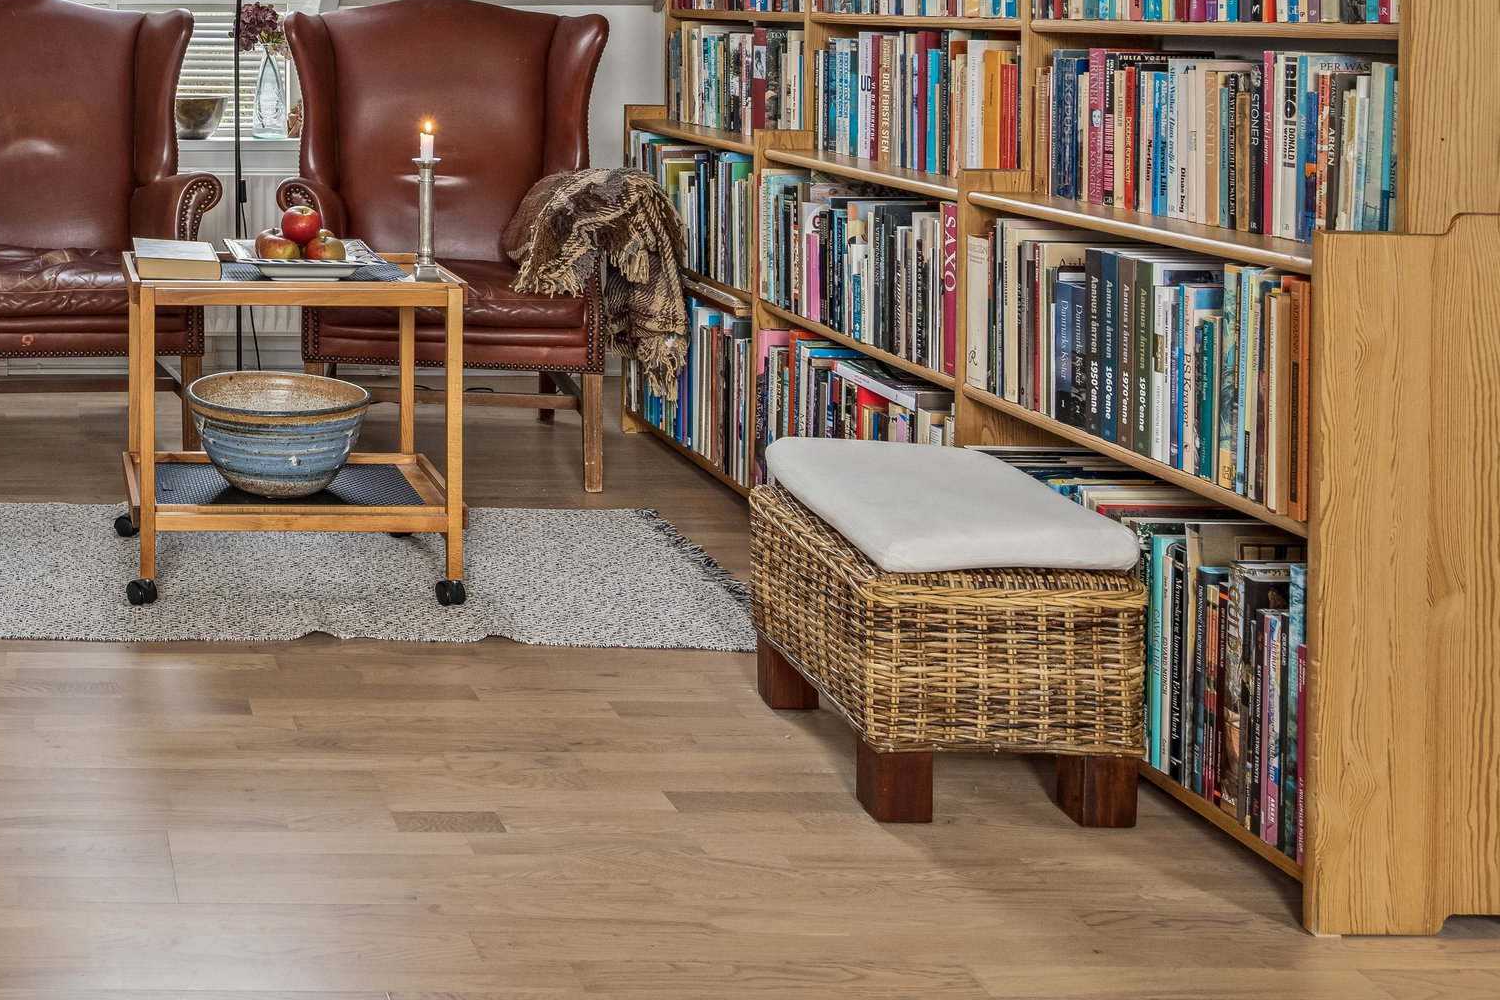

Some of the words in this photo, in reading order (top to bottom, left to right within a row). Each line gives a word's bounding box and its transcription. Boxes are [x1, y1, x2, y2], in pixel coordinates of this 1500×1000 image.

[882, 73, 890, 92] DEN
[1089, 51, 1098, 104] VIRKNER
[1320, 62, 1341, 71] PER
[1064, 74, 1073, 135] EXODUS
[1284, 64, 1297, 119] BIKO
[1104, 114, 1113, 152] KVINDERNES
[1251, 93, 1259, 146] STONER
[881, 129, 889, 153] STEN
[1168, 140, 1176, 164] tredje
[1287, 128, 1296, 160] DONALD
[1104, 153, 1113, 191] DECAMERON
[1179, 195, 1187, 213] bog
[944, 214, 956, 292] SAXO
[1060, 299, 1068, 349] Danmarks
[1076, 304, 1084, 353] Danmarks
[1291, 298, 1299, 354] LADEMANN
[1060, 351, 1069, 380] Kyster
[1075, 356, 1084, 385] Kyster
[1173, 577, 1183, 620] Mennesket
[1227, 586, 1240, 652] GULD
[1172, 633, 1181, 678] kunstneren
[1171, 680, 1179, 710] Edvard
[1171, 711, 1179, 740] Munch
